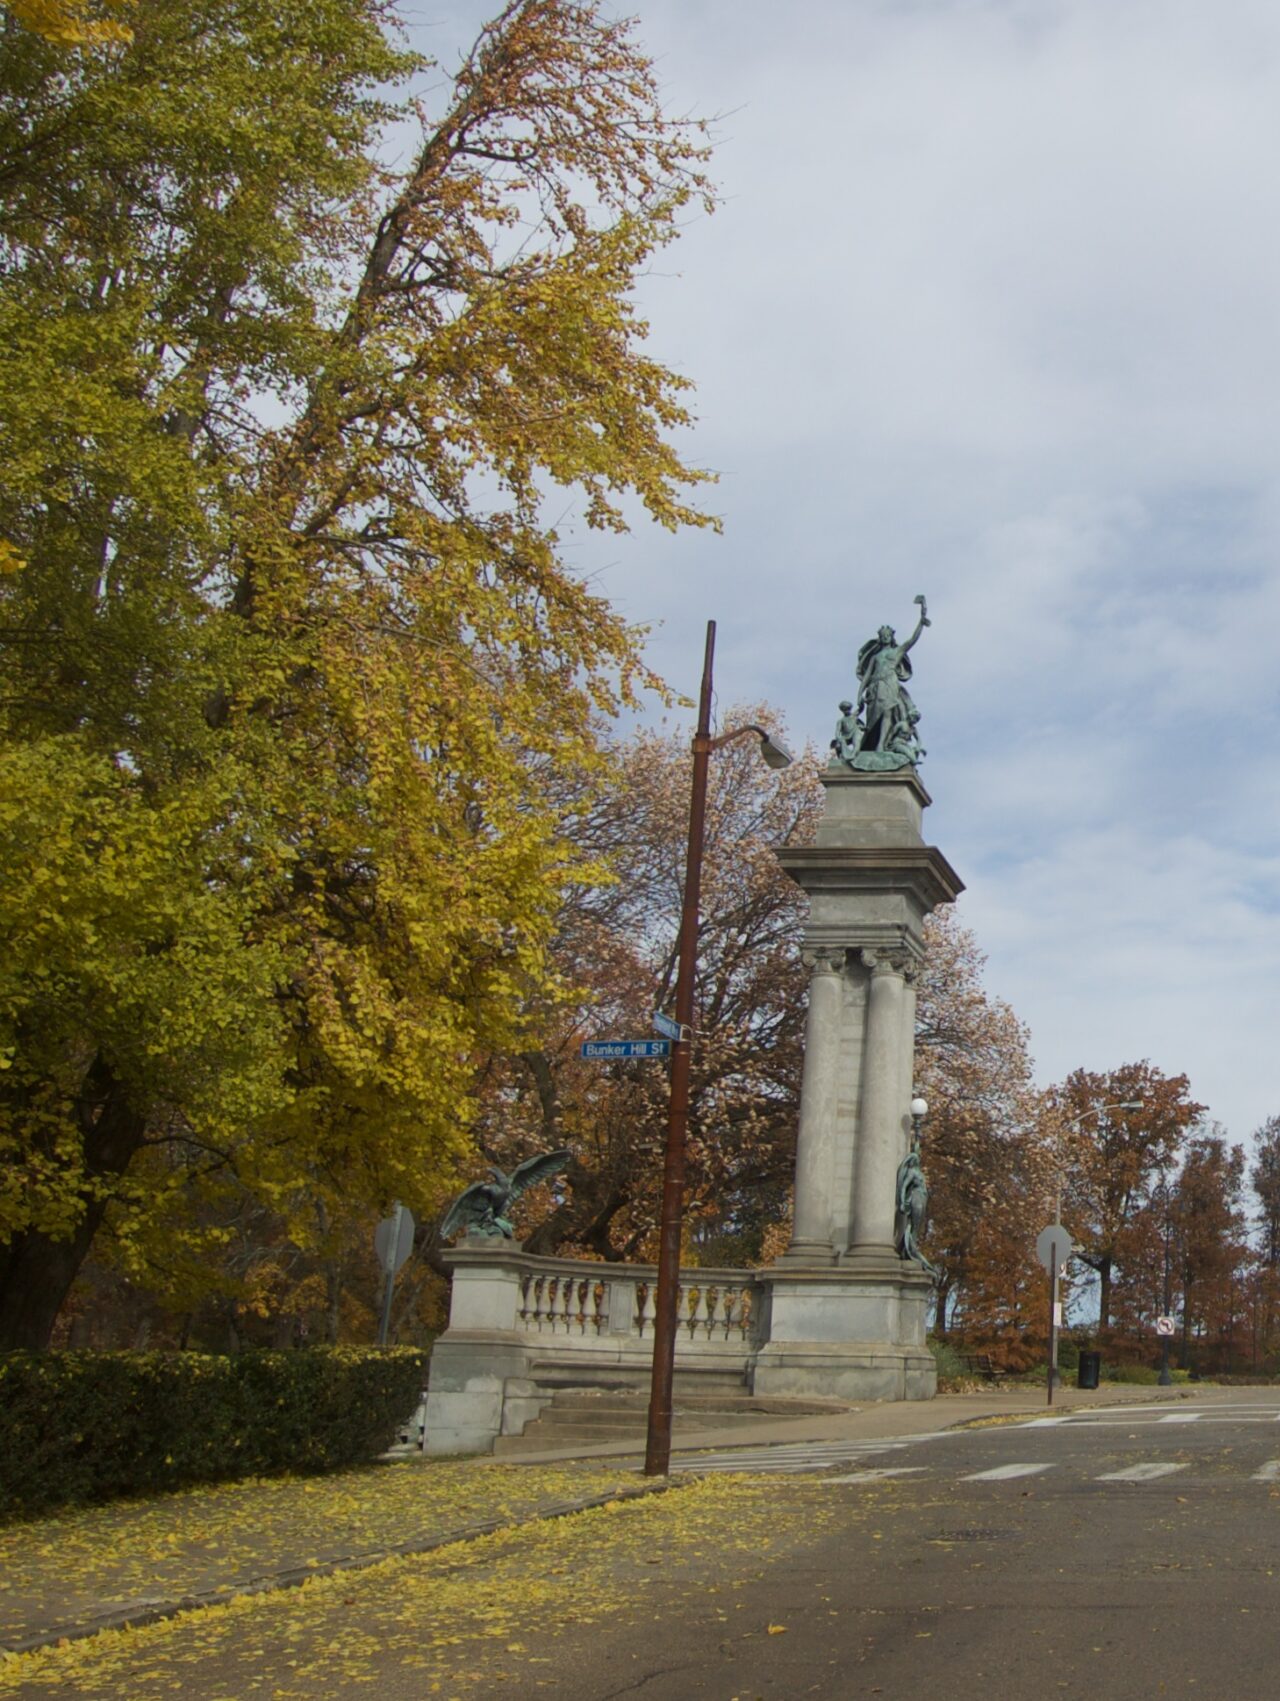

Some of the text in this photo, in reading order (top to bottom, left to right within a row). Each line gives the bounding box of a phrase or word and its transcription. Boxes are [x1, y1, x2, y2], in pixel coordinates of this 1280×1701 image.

[586, 1042, 664, 1056] Bunker Hill St
